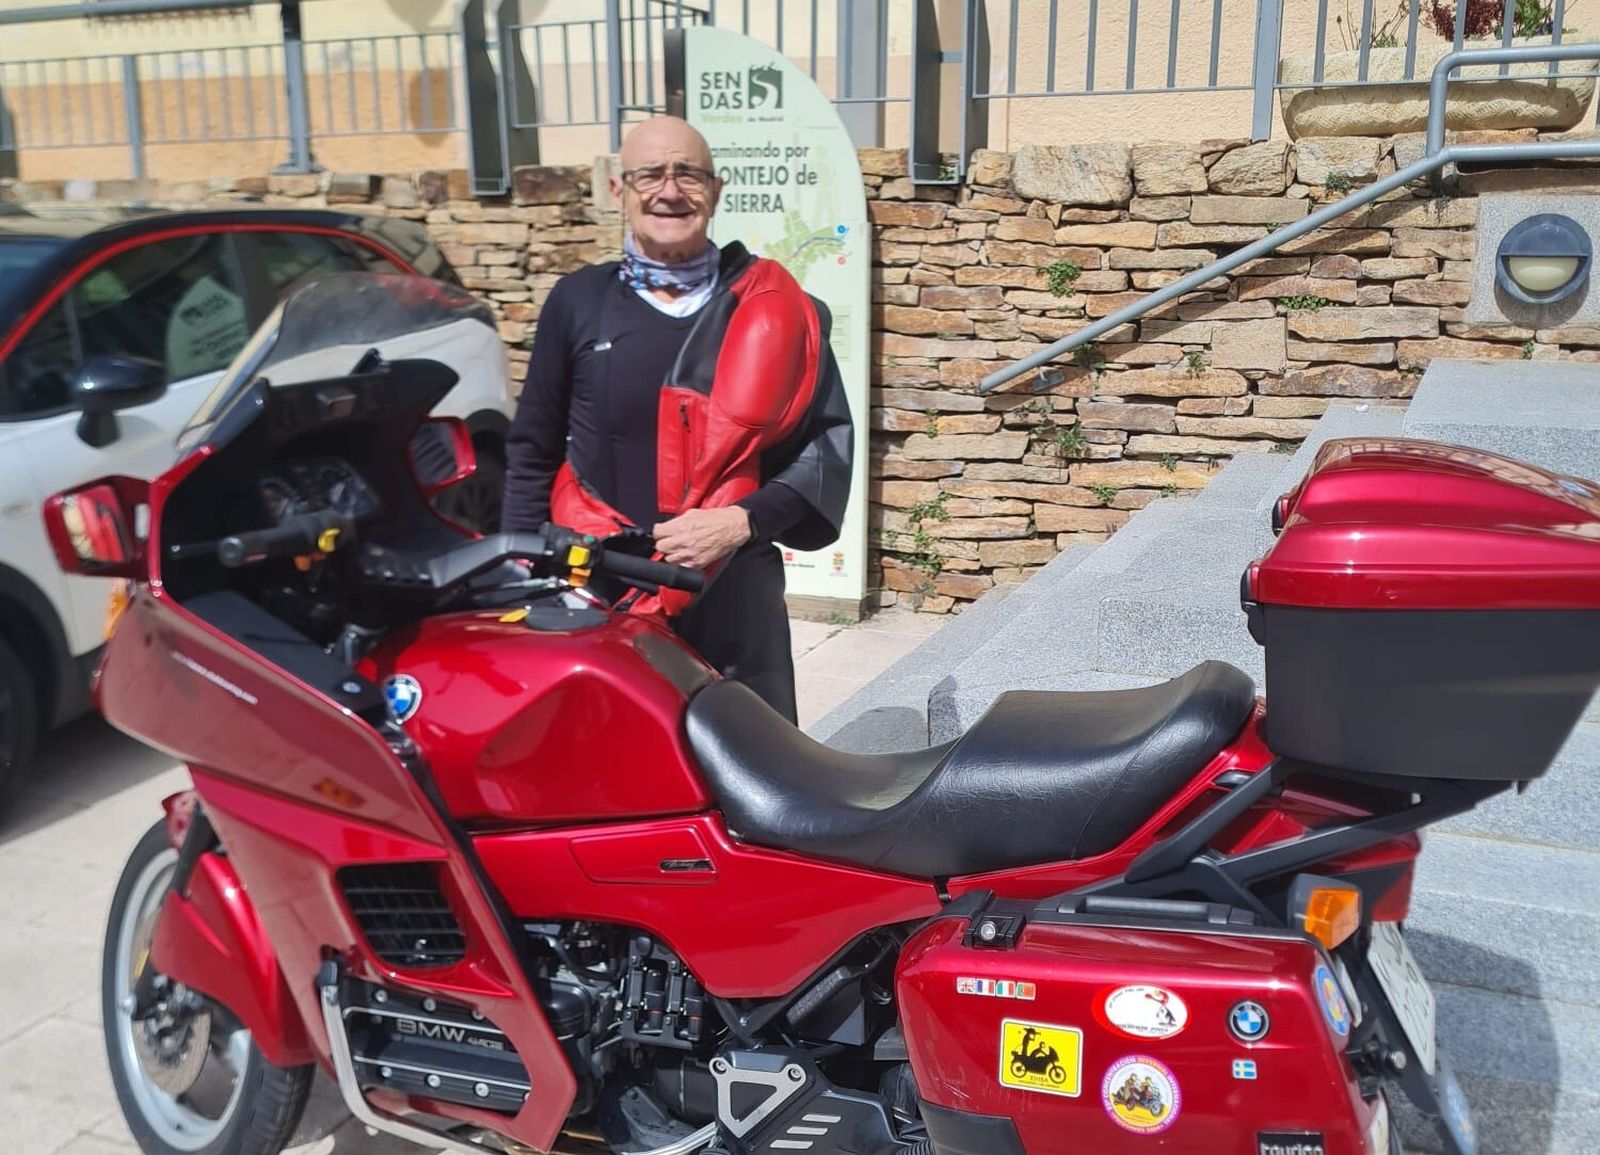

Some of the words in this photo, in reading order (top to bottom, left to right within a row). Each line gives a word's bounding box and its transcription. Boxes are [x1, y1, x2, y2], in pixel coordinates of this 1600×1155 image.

[700, 71, 741, 90] SEN
[700, 91, 743, 110] DAS
[711, 141, 781, 158] aminando
[784, 146, 810, 163] por
[718, 165, 789, 186] ONTEJO
[795, 163, 818, 186] de
[723, 193, 785, 213] SIERRA
[396, 1019, 466, 1042] BMW
